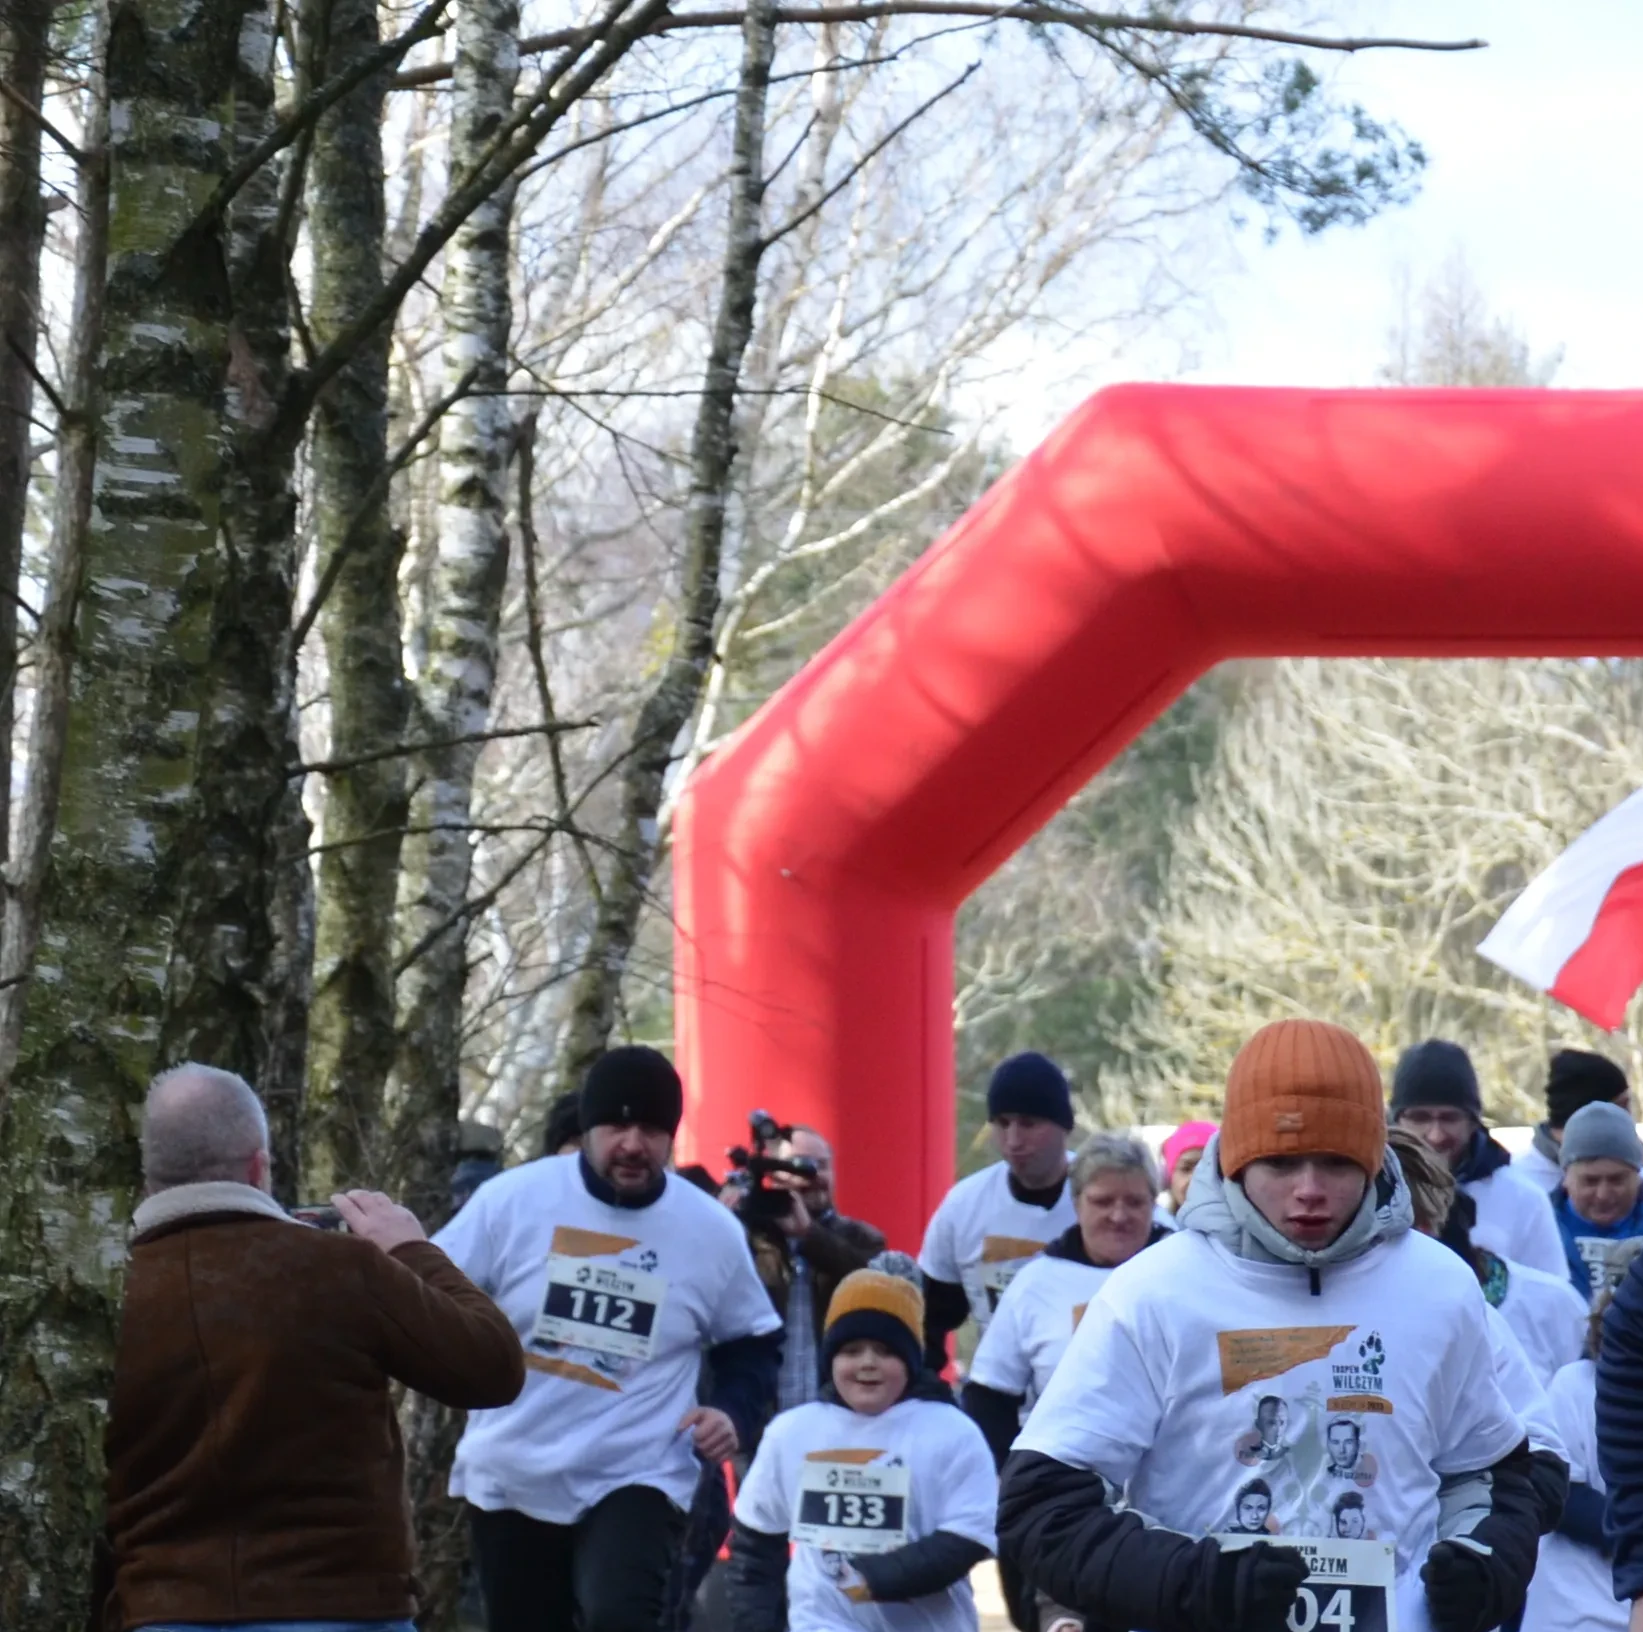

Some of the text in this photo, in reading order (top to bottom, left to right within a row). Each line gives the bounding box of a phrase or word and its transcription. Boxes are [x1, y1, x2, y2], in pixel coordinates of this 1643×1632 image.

[570, 1289, 636, 1330] 112
[1332, 1375, 1383, 1391] WILCZYM
[823, 1494, 885, 1527] 133
[1299, 1545, 1318, 1556] PEM
[1310, 1557, 1348, 1573] CZYM
